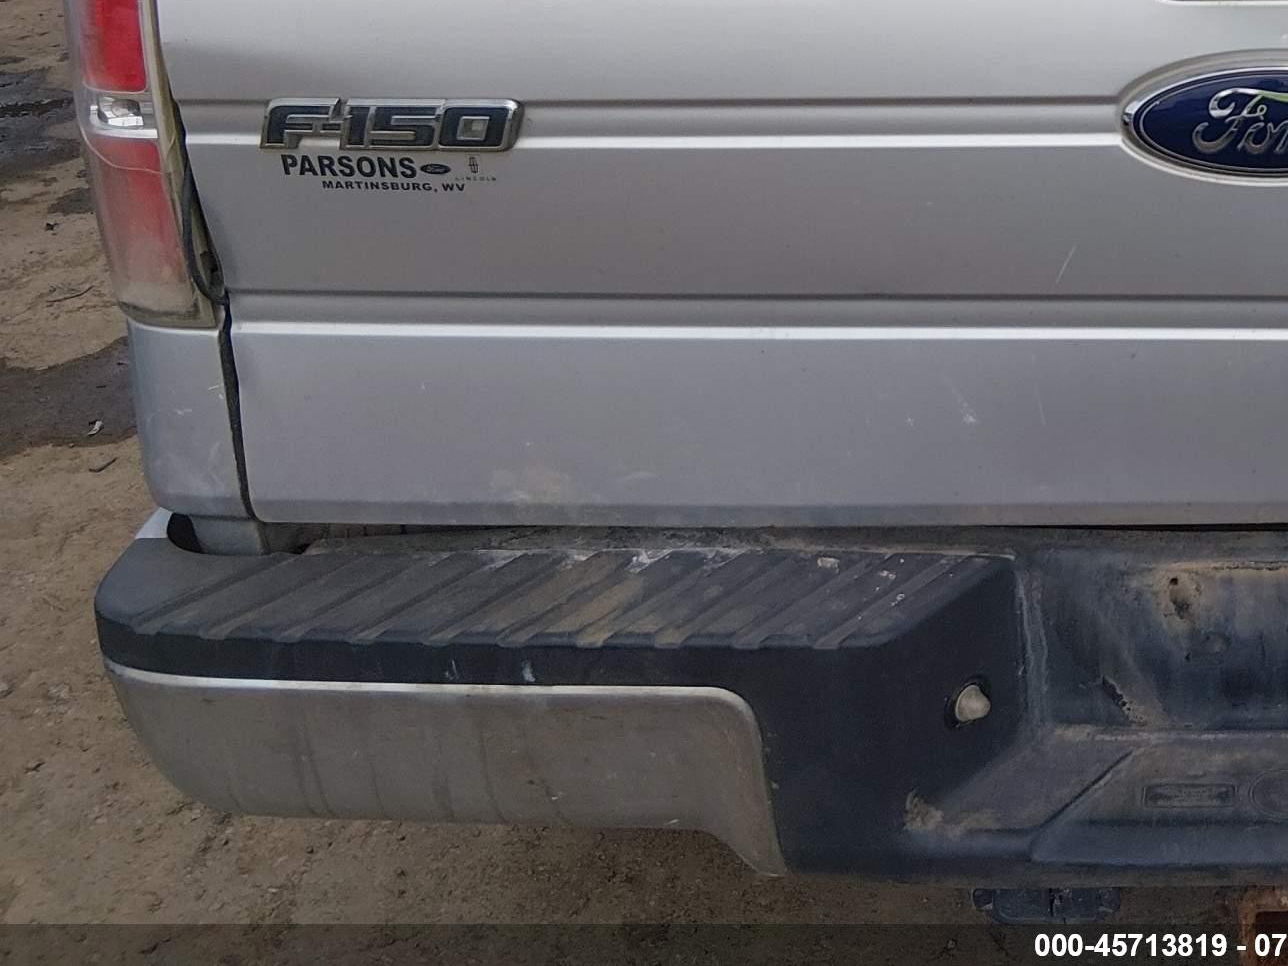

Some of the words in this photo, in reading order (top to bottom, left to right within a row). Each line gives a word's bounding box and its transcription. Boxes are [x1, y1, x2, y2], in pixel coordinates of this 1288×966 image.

[260, 98, 524, 152] F-150
[281, 154, 417, 179] PARSONS
[322, 180, 438, 193] MARTINSBURG,
[441, 183, 466, 192] WV
